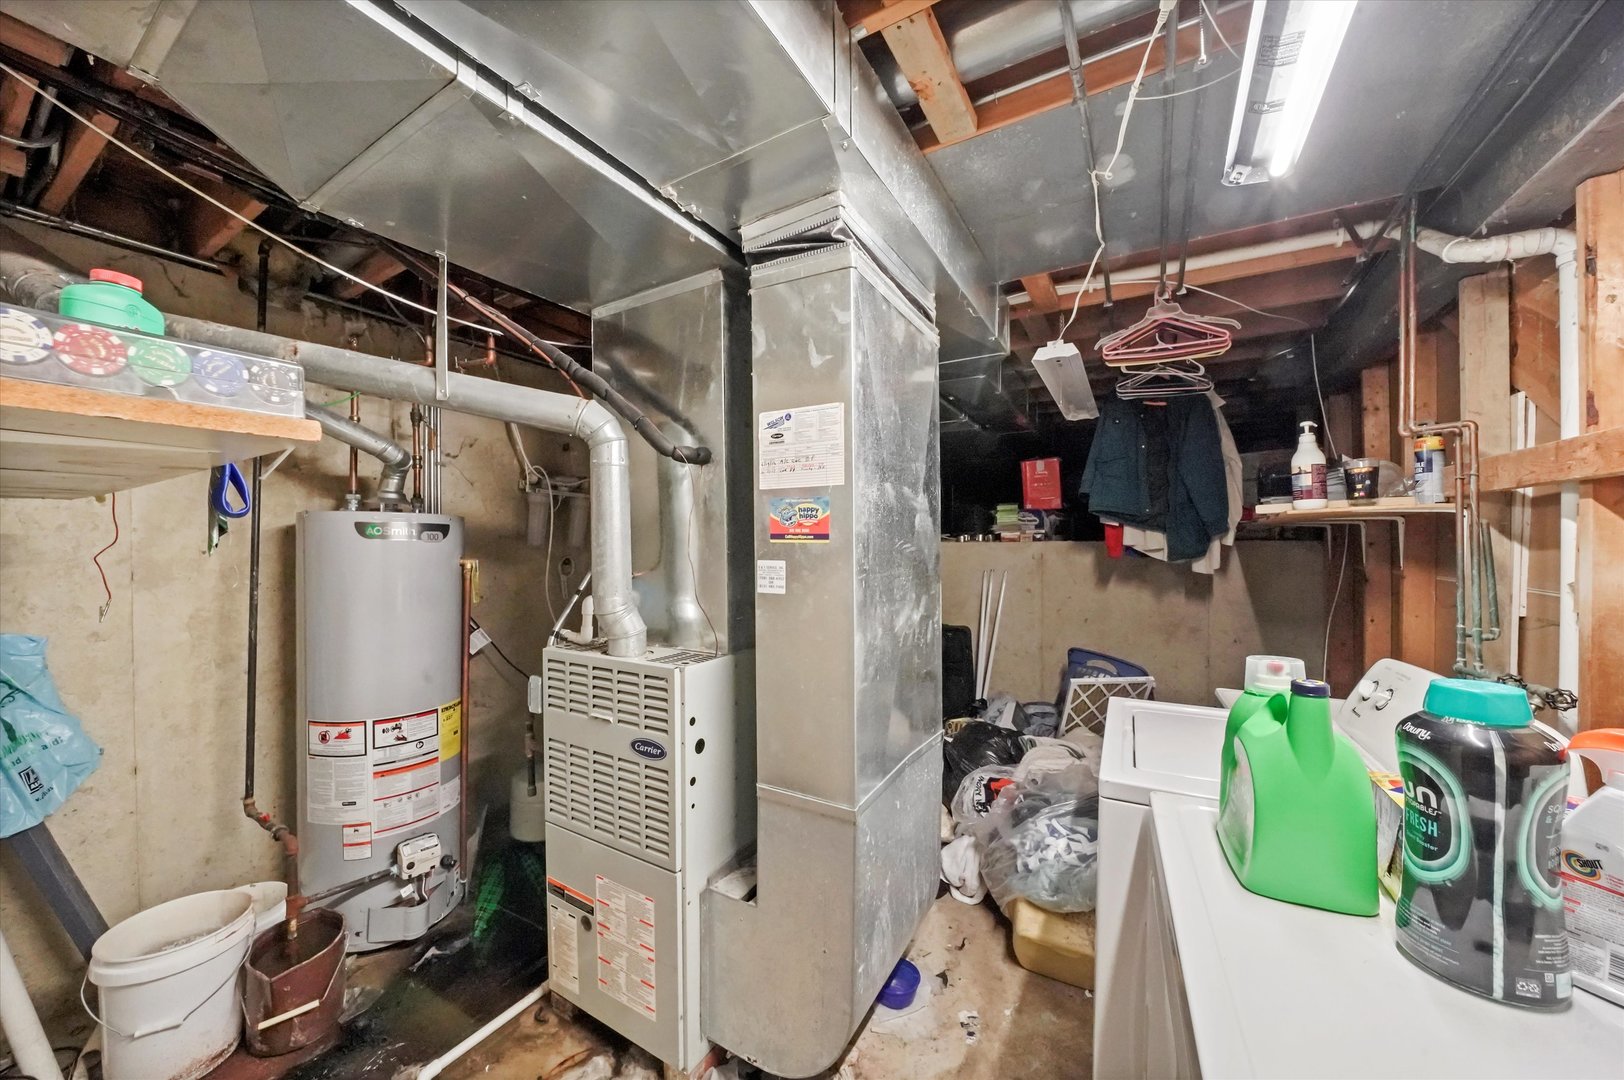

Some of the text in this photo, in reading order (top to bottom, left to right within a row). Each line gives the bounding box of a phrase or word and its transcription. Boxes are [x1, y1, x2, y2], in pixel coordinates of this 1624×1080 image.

[797, 507, 820, 515] happy
[426, 533, 440, 542] 100
[1402, 721, 1427, 740] Downy
[634, 742, 662, 755] Carrier
[1405, 807, 1438, 837] FRESH
[1576, 858, 1603, 870] SHOUT
